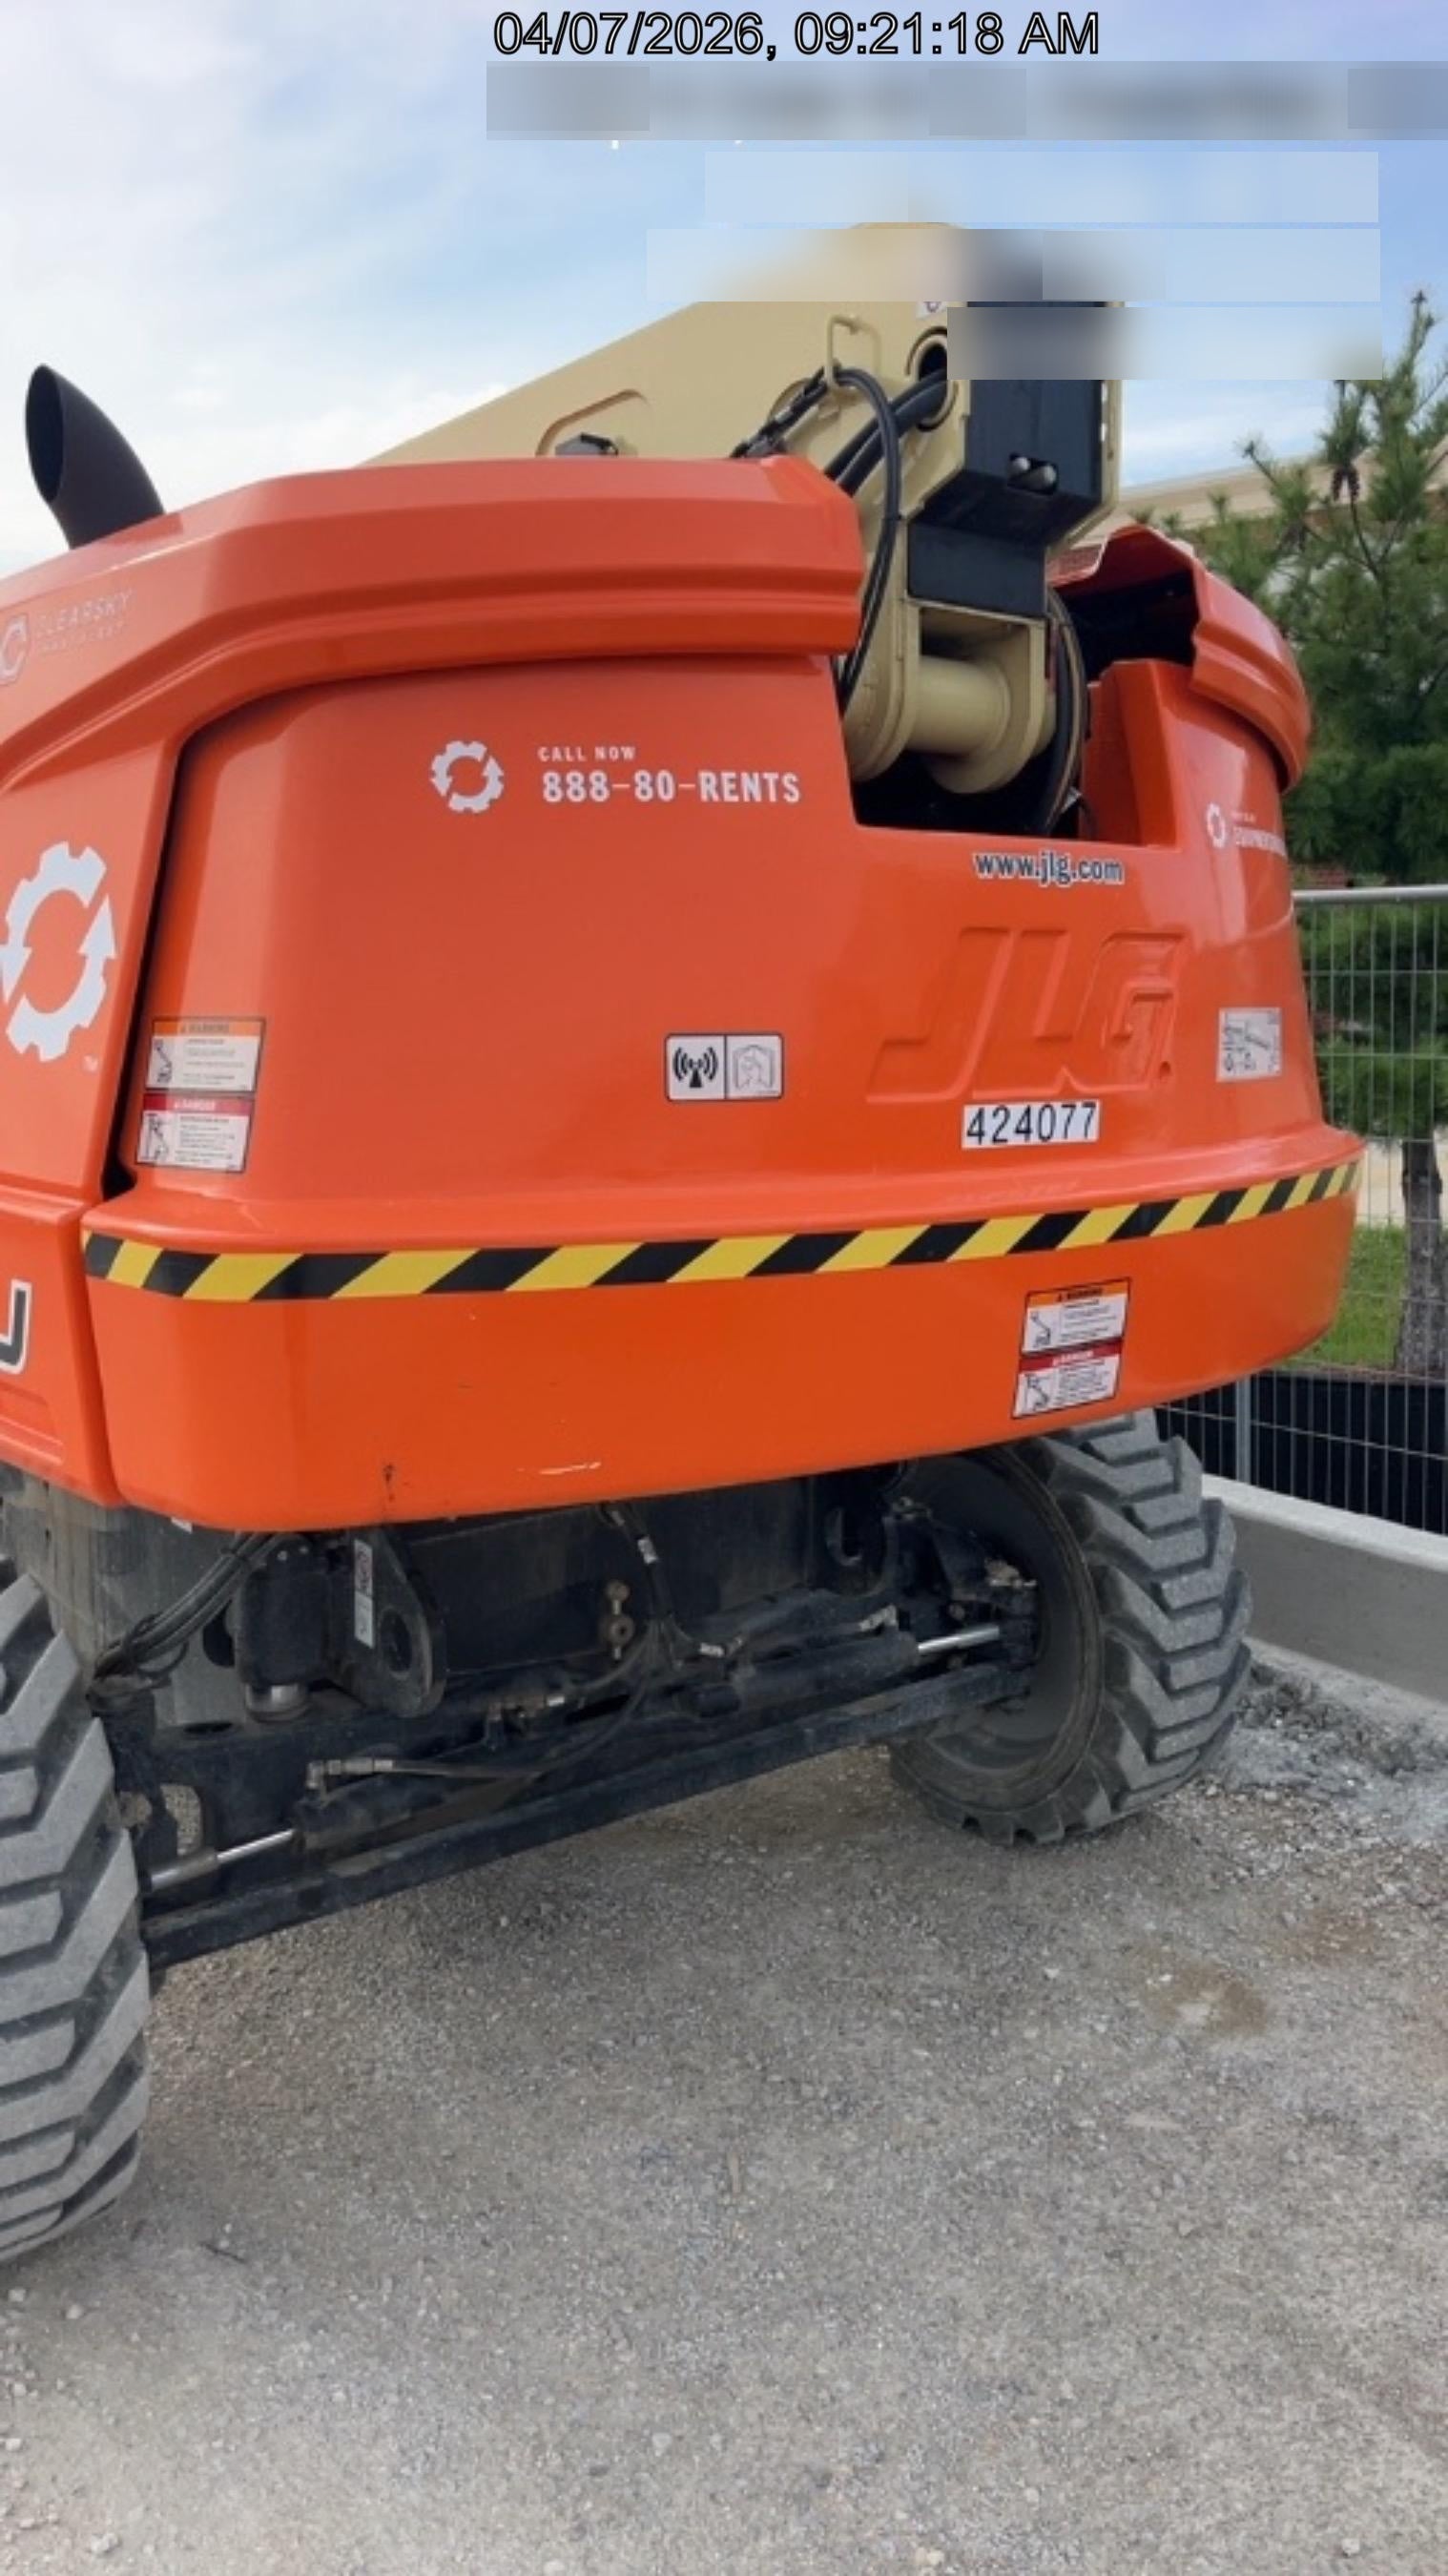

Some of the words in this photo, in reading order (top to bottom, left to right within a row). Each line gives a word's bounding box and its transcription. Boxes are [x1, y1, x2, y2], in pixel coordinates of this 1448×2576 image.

[538, 746, 586, 762] CALL
[594, 746, 636, 761] NOW
[543, 768, 800, 803] 888-80-RENTS
[973, 848, 1125, 887] www.jlg.com
[865, 926, 1192, 1102] JLG
[965, 1102, 1097, 1145] 424077
